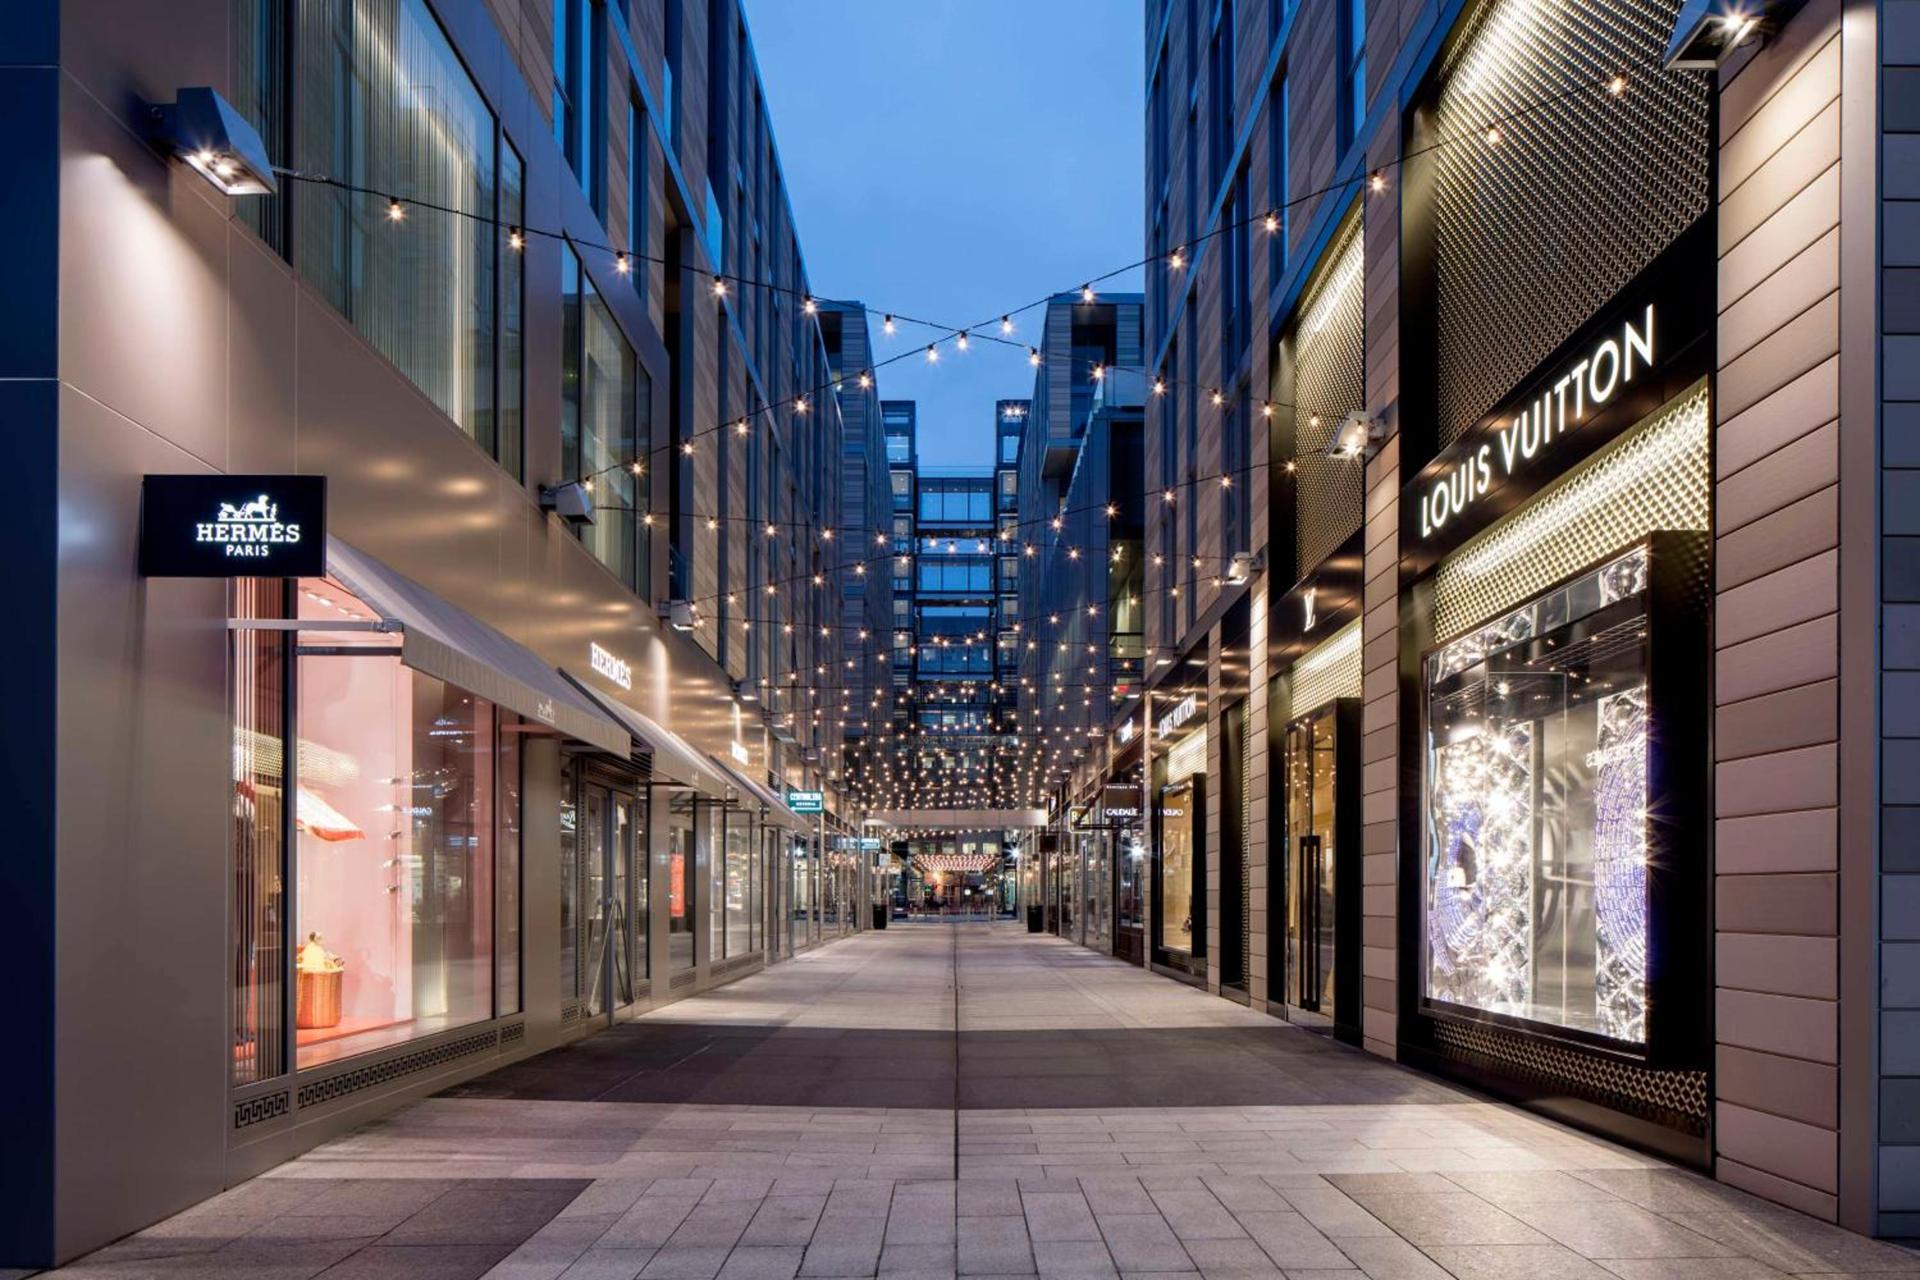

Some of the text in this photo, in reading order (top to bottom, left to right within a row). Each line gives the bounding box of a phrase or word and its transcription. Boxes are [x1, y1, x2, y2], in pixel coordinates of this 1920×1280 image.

[1421, 303, 1655, 539] LOUIS VUITTON
[226, 545, 270, 557] PARIS
